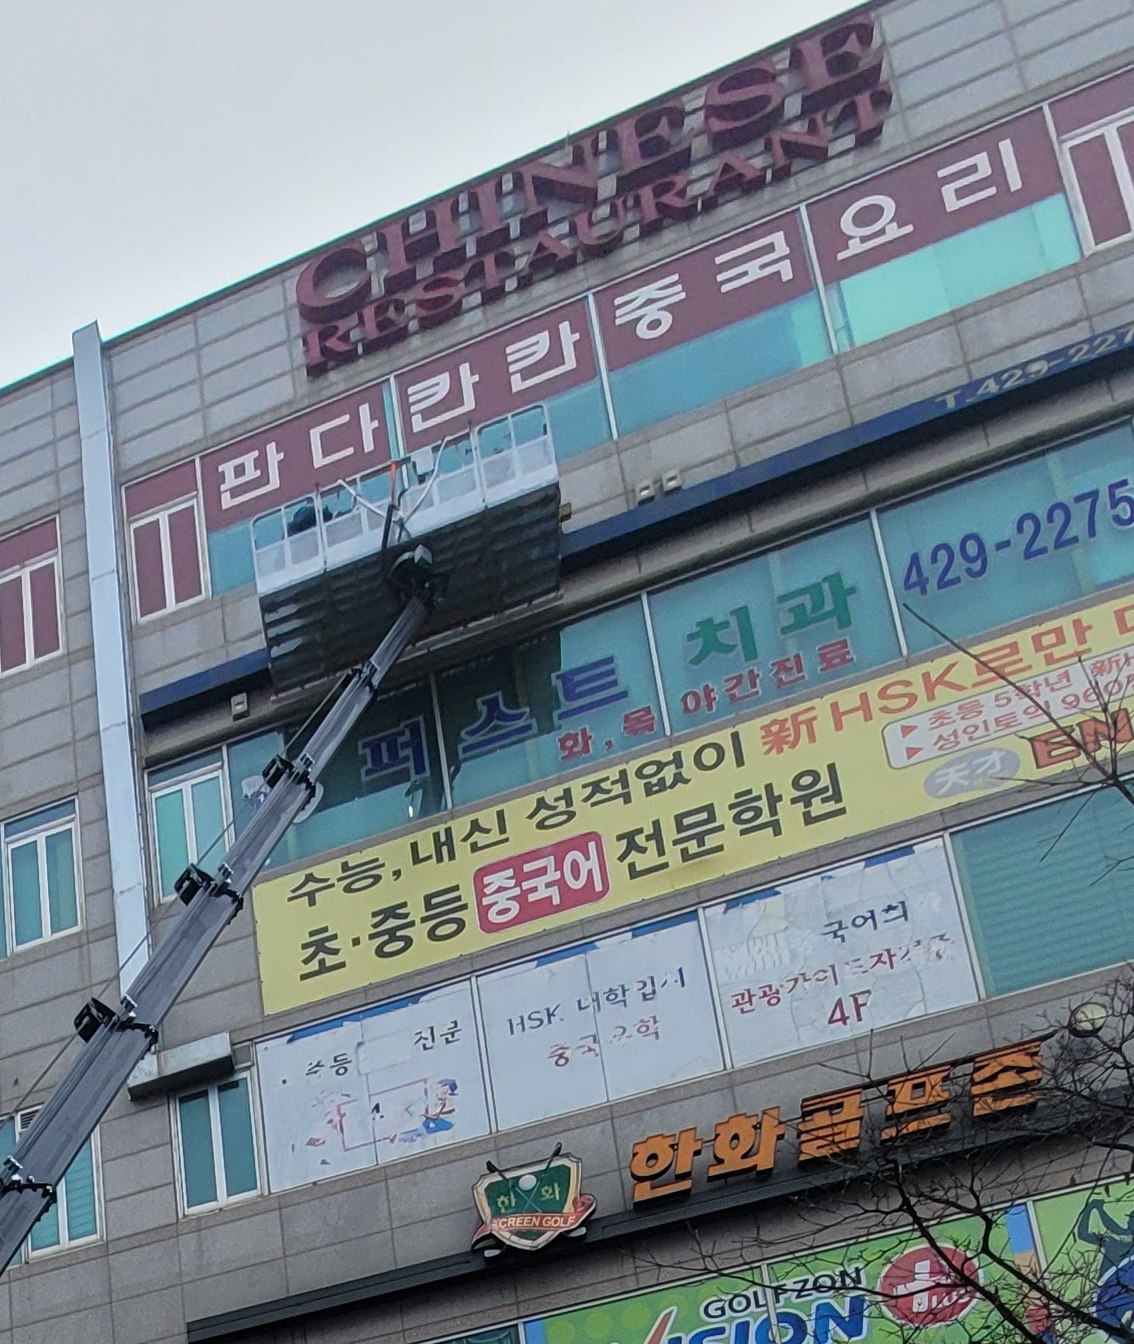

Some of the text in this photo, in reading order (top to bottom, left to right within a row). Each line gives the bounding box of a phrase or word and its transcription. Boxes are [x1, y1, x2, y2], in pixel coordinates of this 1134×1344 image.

[296, 15, 884, 326] CHINESE
[304, 85, 894, 378] RESTAURANT
[903, 479, 1134, 596] 429-2275
[526, 731, 746, 830] 성적없이
[480, 838, 606, 925] 중국어
[615, 761, 848, 881] 전문학원
[542, 1215, 576, 1228] GOLF
[703, 1266, 862, 1319] GOLFZON
